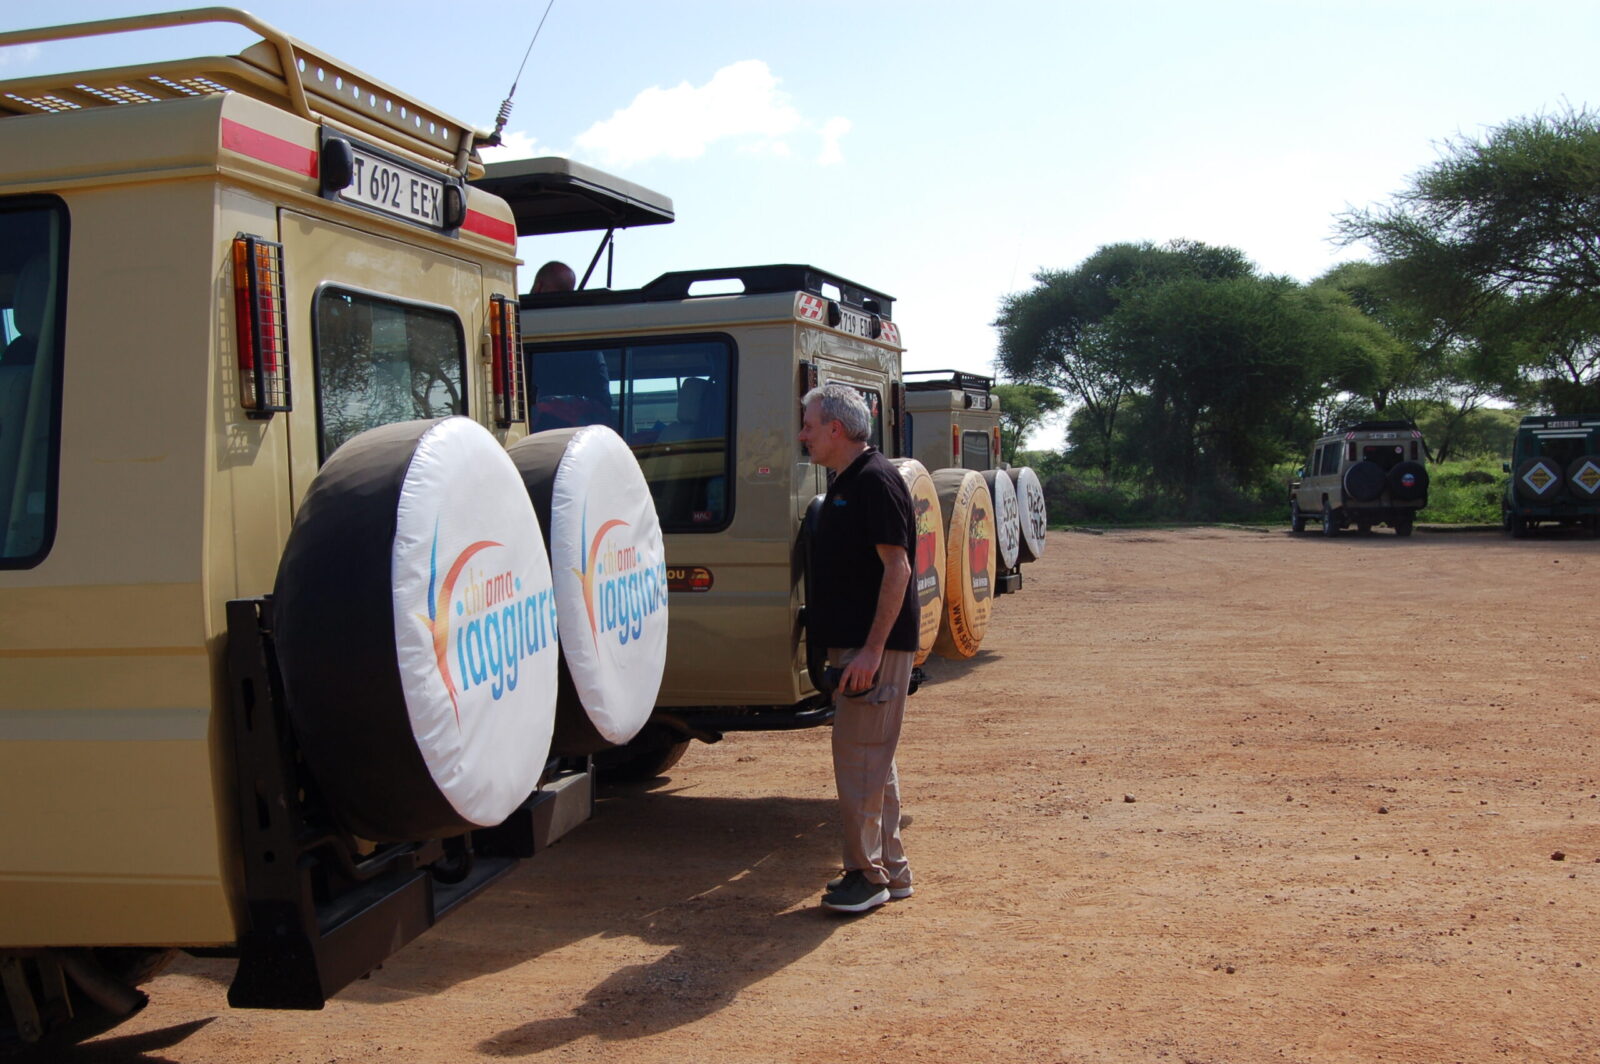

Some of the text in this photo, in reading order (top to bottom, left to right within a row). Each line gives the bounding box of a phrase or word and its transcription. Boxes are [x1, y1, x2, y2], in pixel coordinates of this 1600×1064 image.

[354, 157, 440, 222] T 692 EEX
[464, 567, 514, 617] chiama
